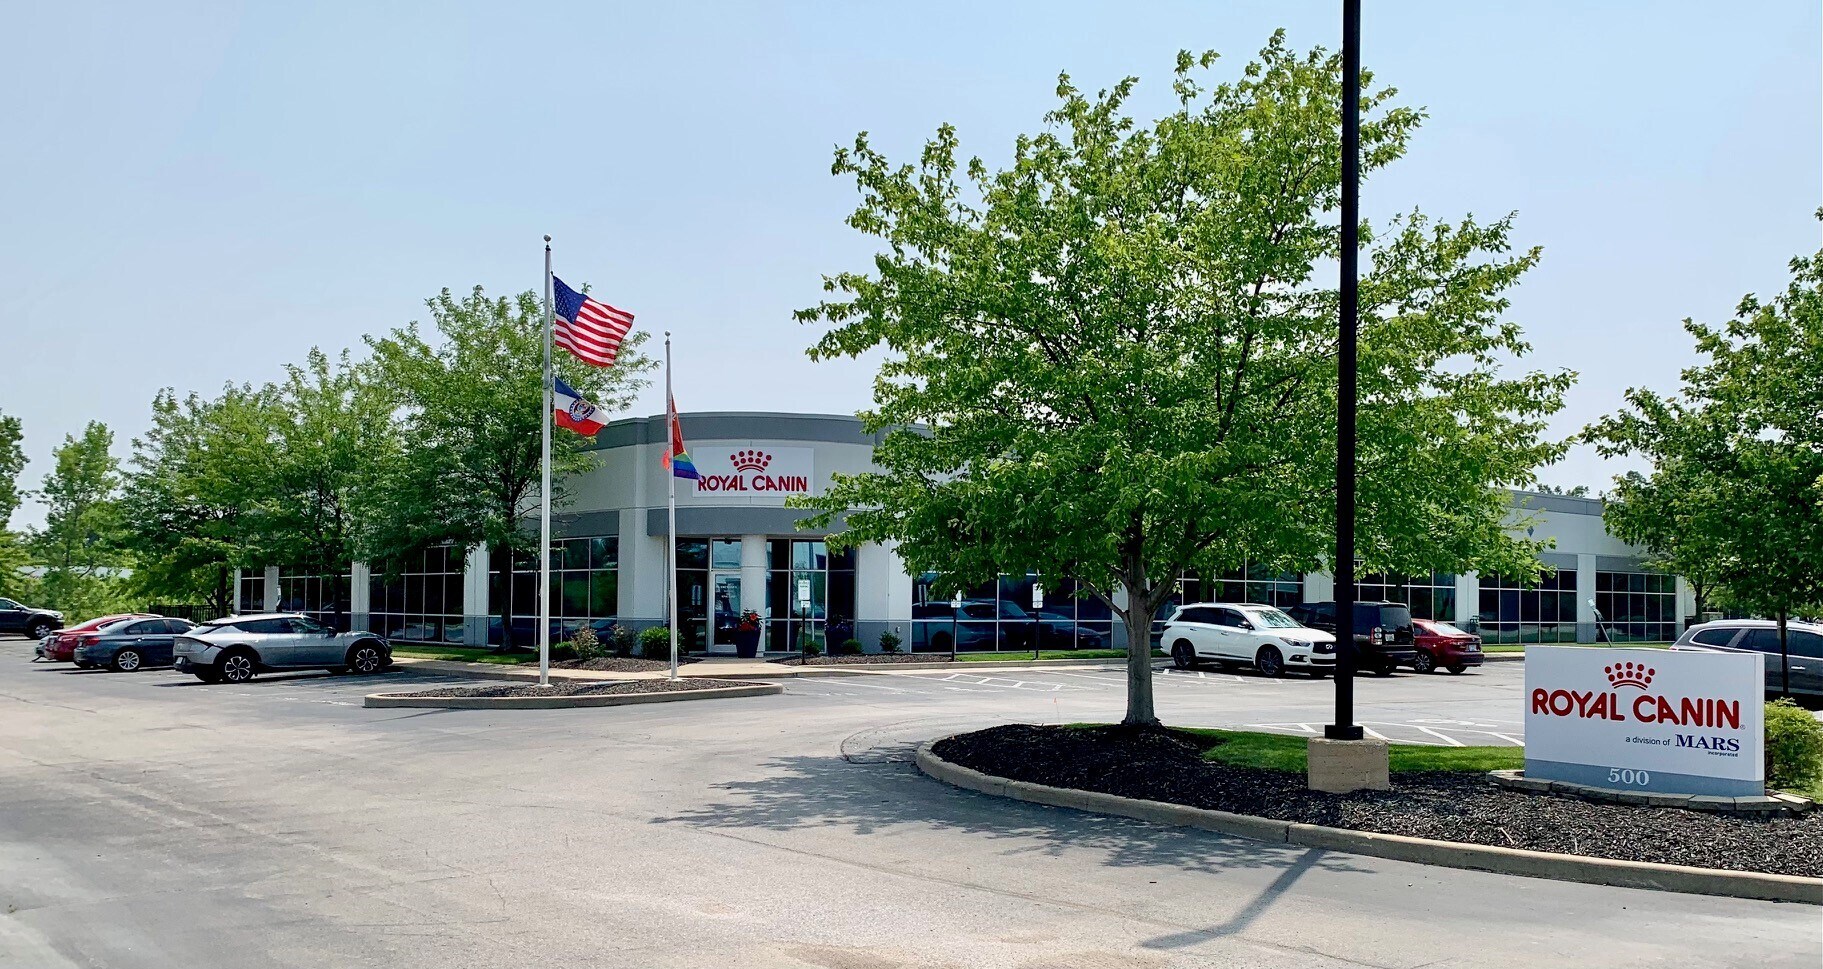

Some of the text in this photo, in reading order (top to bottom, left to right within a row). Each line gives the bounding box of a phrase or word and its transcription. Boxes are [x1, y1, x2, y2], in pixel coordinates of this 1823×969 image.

[697, 474, 808, 492] ROYAL CANIN
[1532, 688, 1740, 730] ROYAL CANIN
[1632, 735, 1661, 746] division
[1662, 738, 1671, 747] of
[1674, 733, 1740, 752] MARS
[1607, 768, 1650, 786] 500
